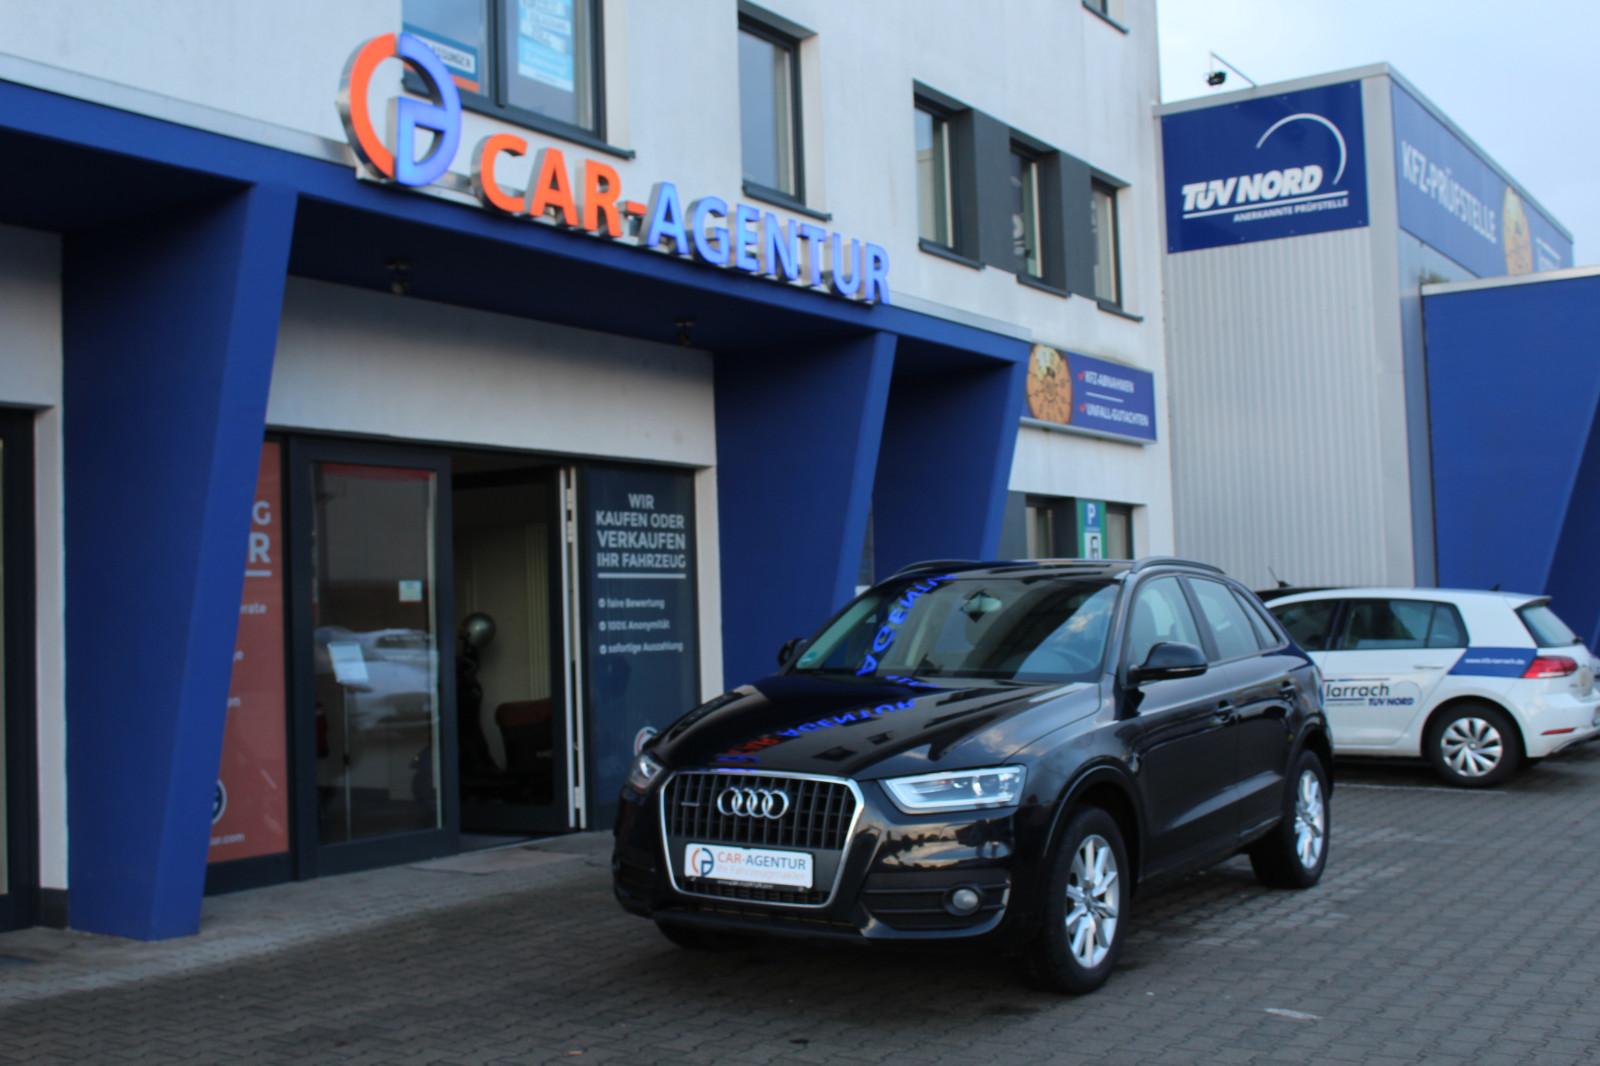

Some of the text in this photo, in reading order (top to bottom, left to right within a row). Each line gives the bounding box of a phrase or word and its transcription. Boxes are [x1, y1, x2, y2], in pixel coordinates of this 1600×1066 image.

[1182, 164, 1324, 212] TÜV NORD
[1401, 140, 1497, 244] KFZ-PRÜFSTELLE
[478, 133, 891, 305] CAR-AGENTUR
[1232, 198, 1349, 223] ANERKANNTE PRÜFSTELLE
[628, 493, 655, 510] WIR
[595, 510, 685, 529] KAUFEN ODER
[1087, 503, 1097, 526] P
[596, 530, 686, 550] VERKAUFEN
[596, 552, 687, 569] IHR FAHRZEUG
[625, 598, 665, 610] Bewertung
[1387, 697, 1414, 706] NORD
[717, 851, 806, 870] CAR-AGENTUR
